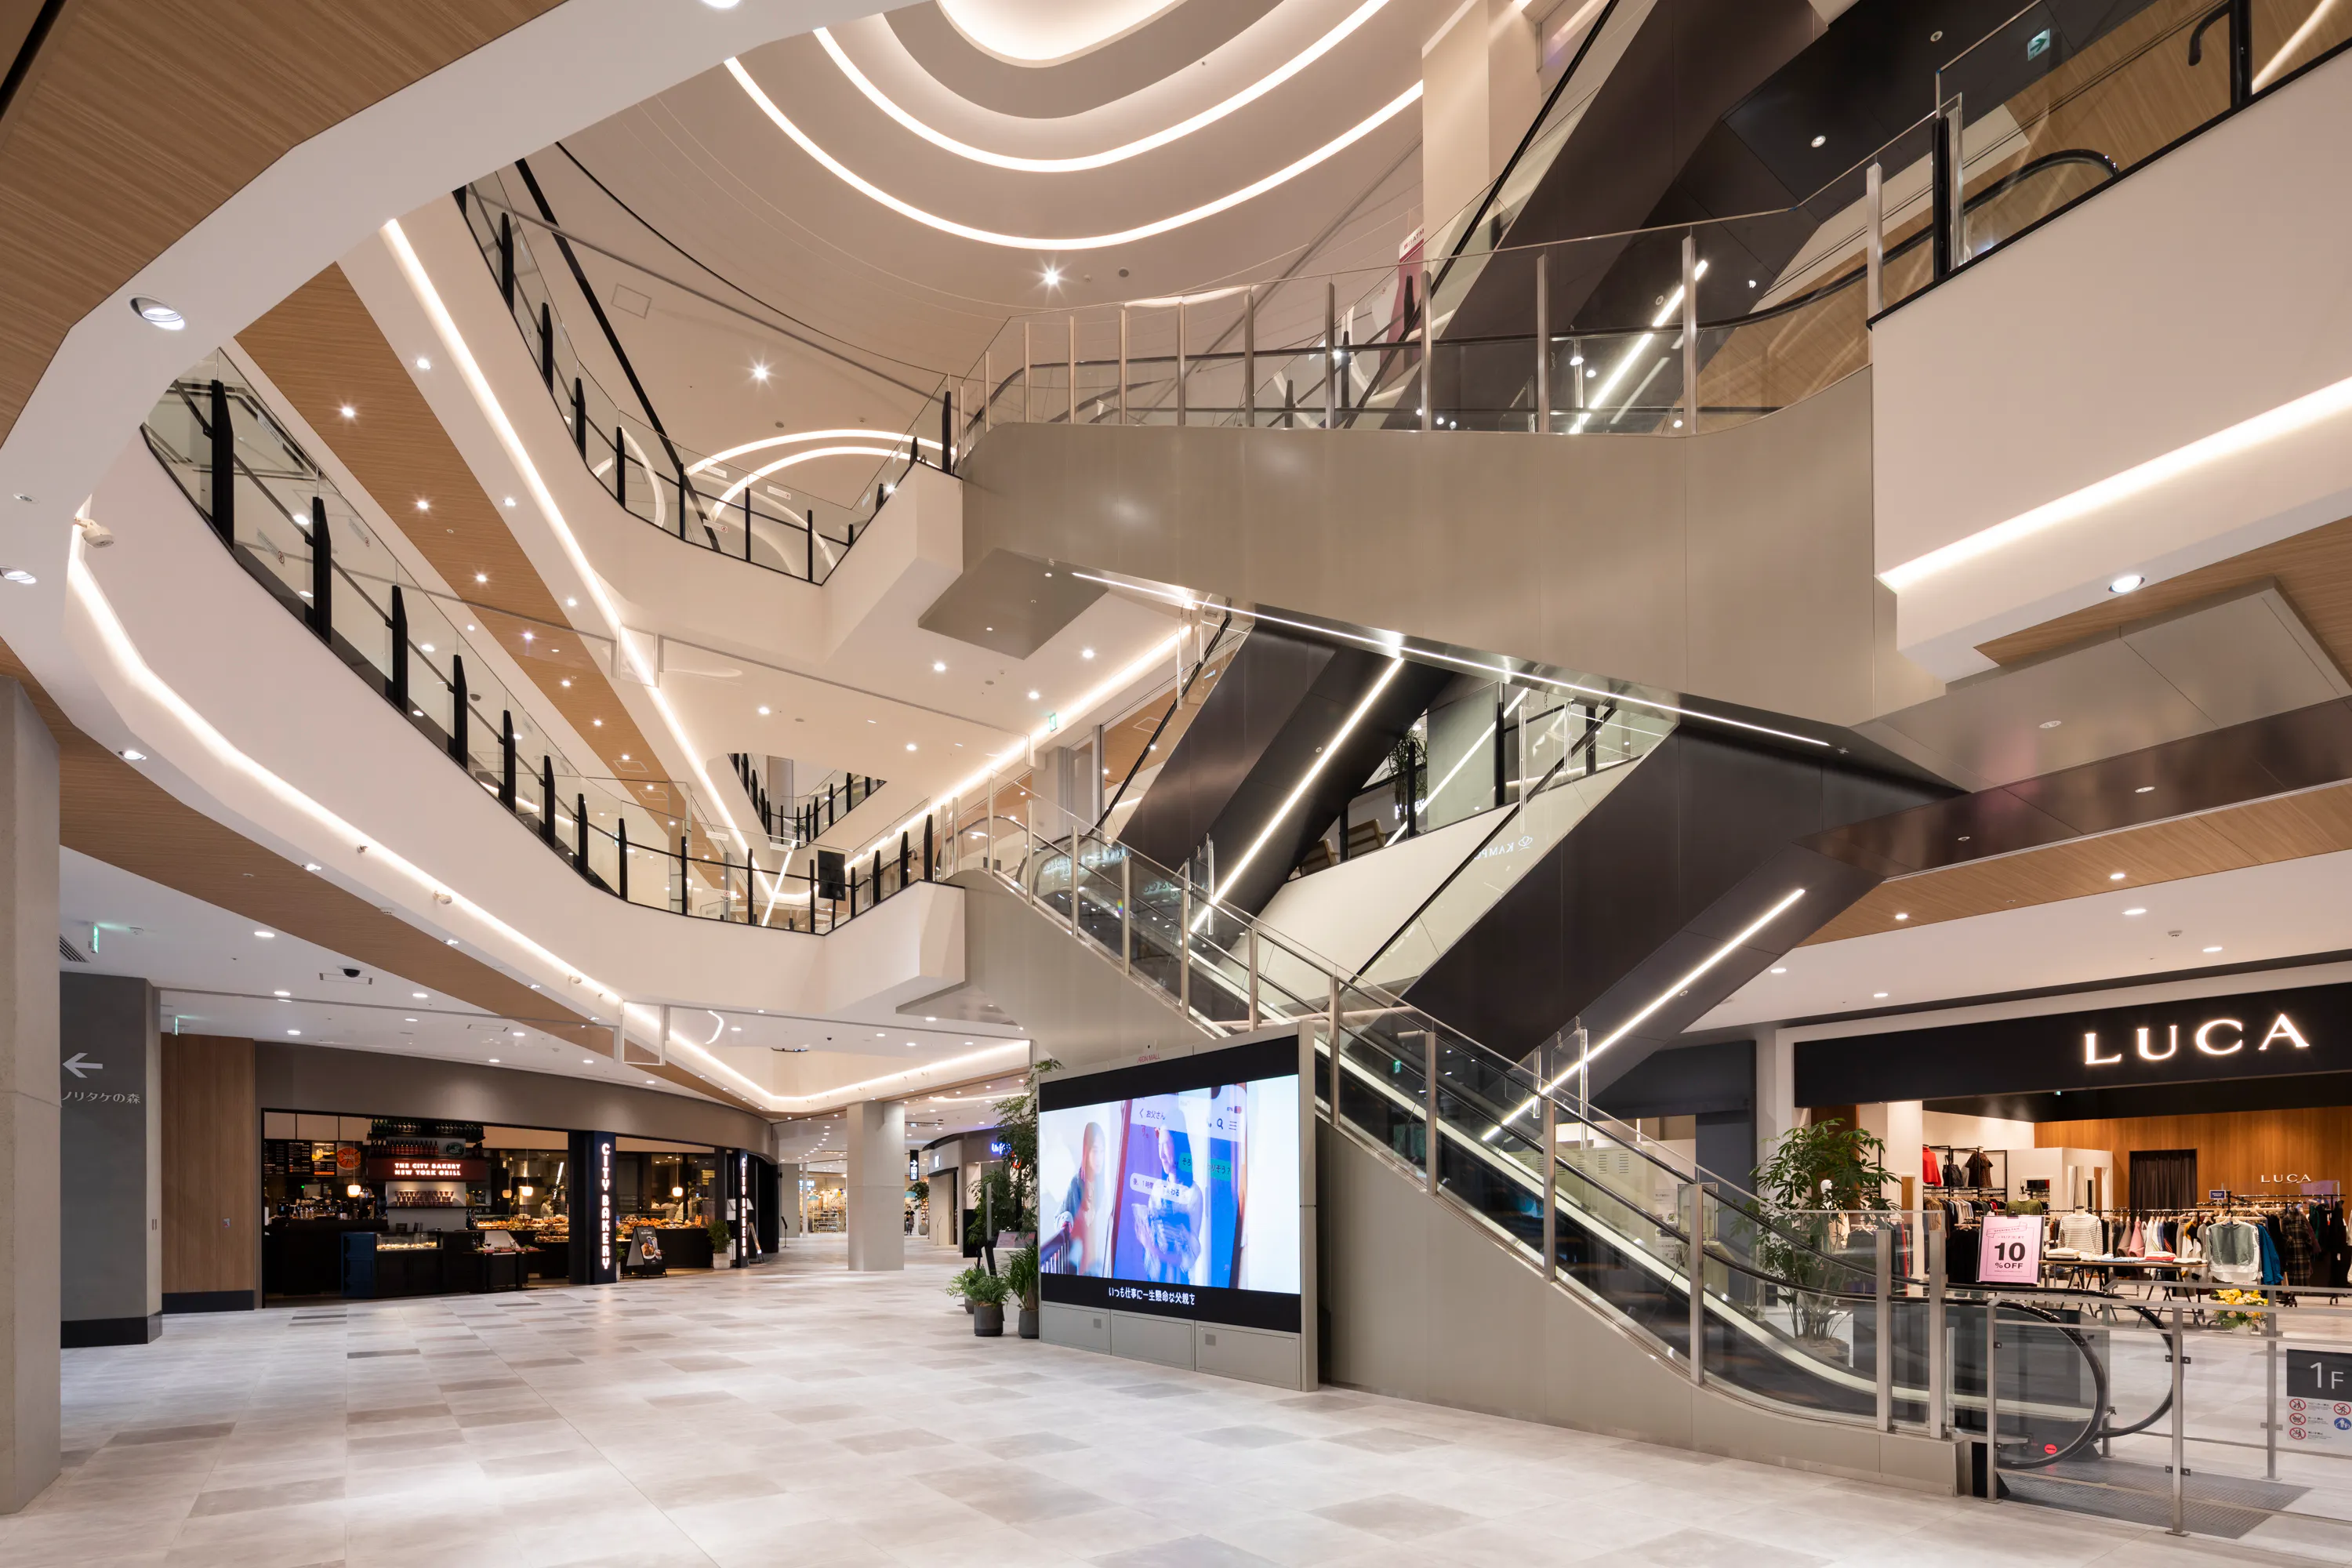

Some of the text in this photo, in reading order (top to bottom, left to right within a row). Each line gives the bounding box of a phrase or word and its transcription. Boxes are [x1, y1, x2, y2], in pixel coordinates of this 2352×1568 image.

[2085, 1013, 2310, 1065] LUCA
[62, 1091, 140, 1104] ノリタケの森
[1146, 1110, 1166, 1120] お父さん
[2261, 1174, 2311, 1183] LUCA
[601, 1143, 611, 1270] CITY BAKERY
[1994, 1242, 2025, 1261] 10
[1109, 1287, 1196, 1305] いつも仕事に一生懸命な父親を
